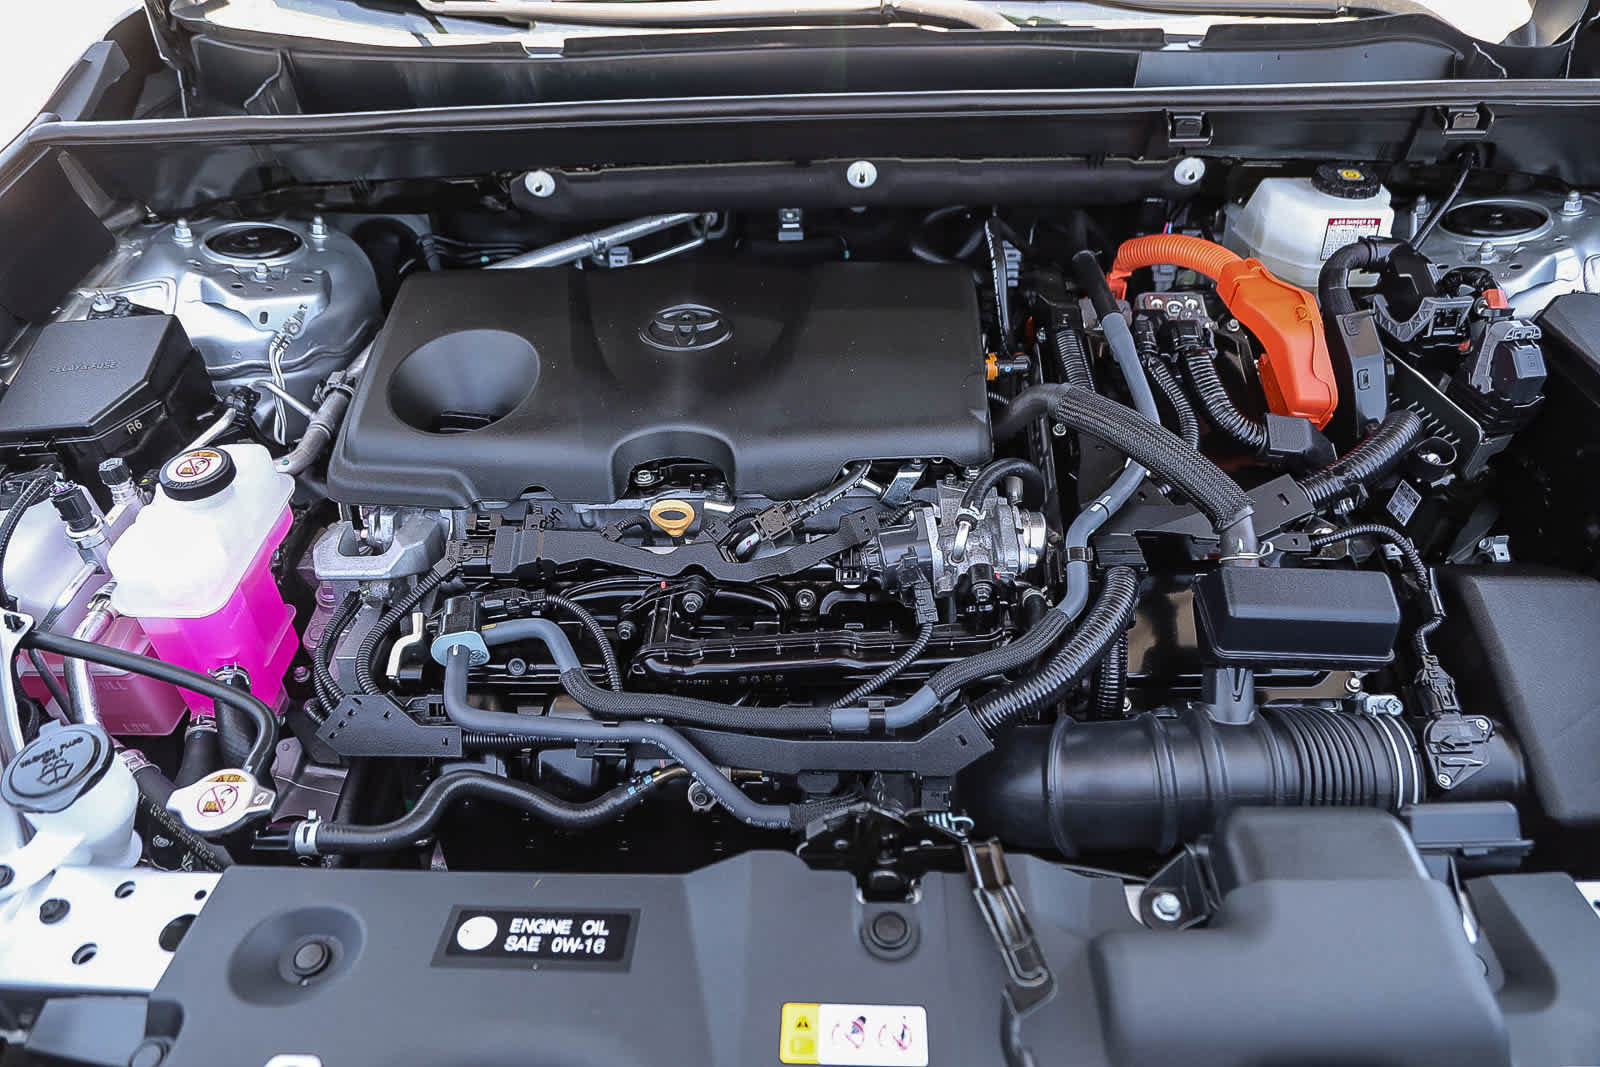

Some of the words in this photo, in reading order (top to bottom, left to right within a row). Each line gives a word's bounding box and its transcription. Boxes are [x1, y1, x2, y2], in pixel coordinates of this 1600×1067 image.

[126, 419, 143, 435] R6
[509, 917, 573, 935] ENGINE
[581, 919, 609, 936] OIL
[504, 935, 541, 952] SAE
[550, 936, 606, 954] 0W-16
